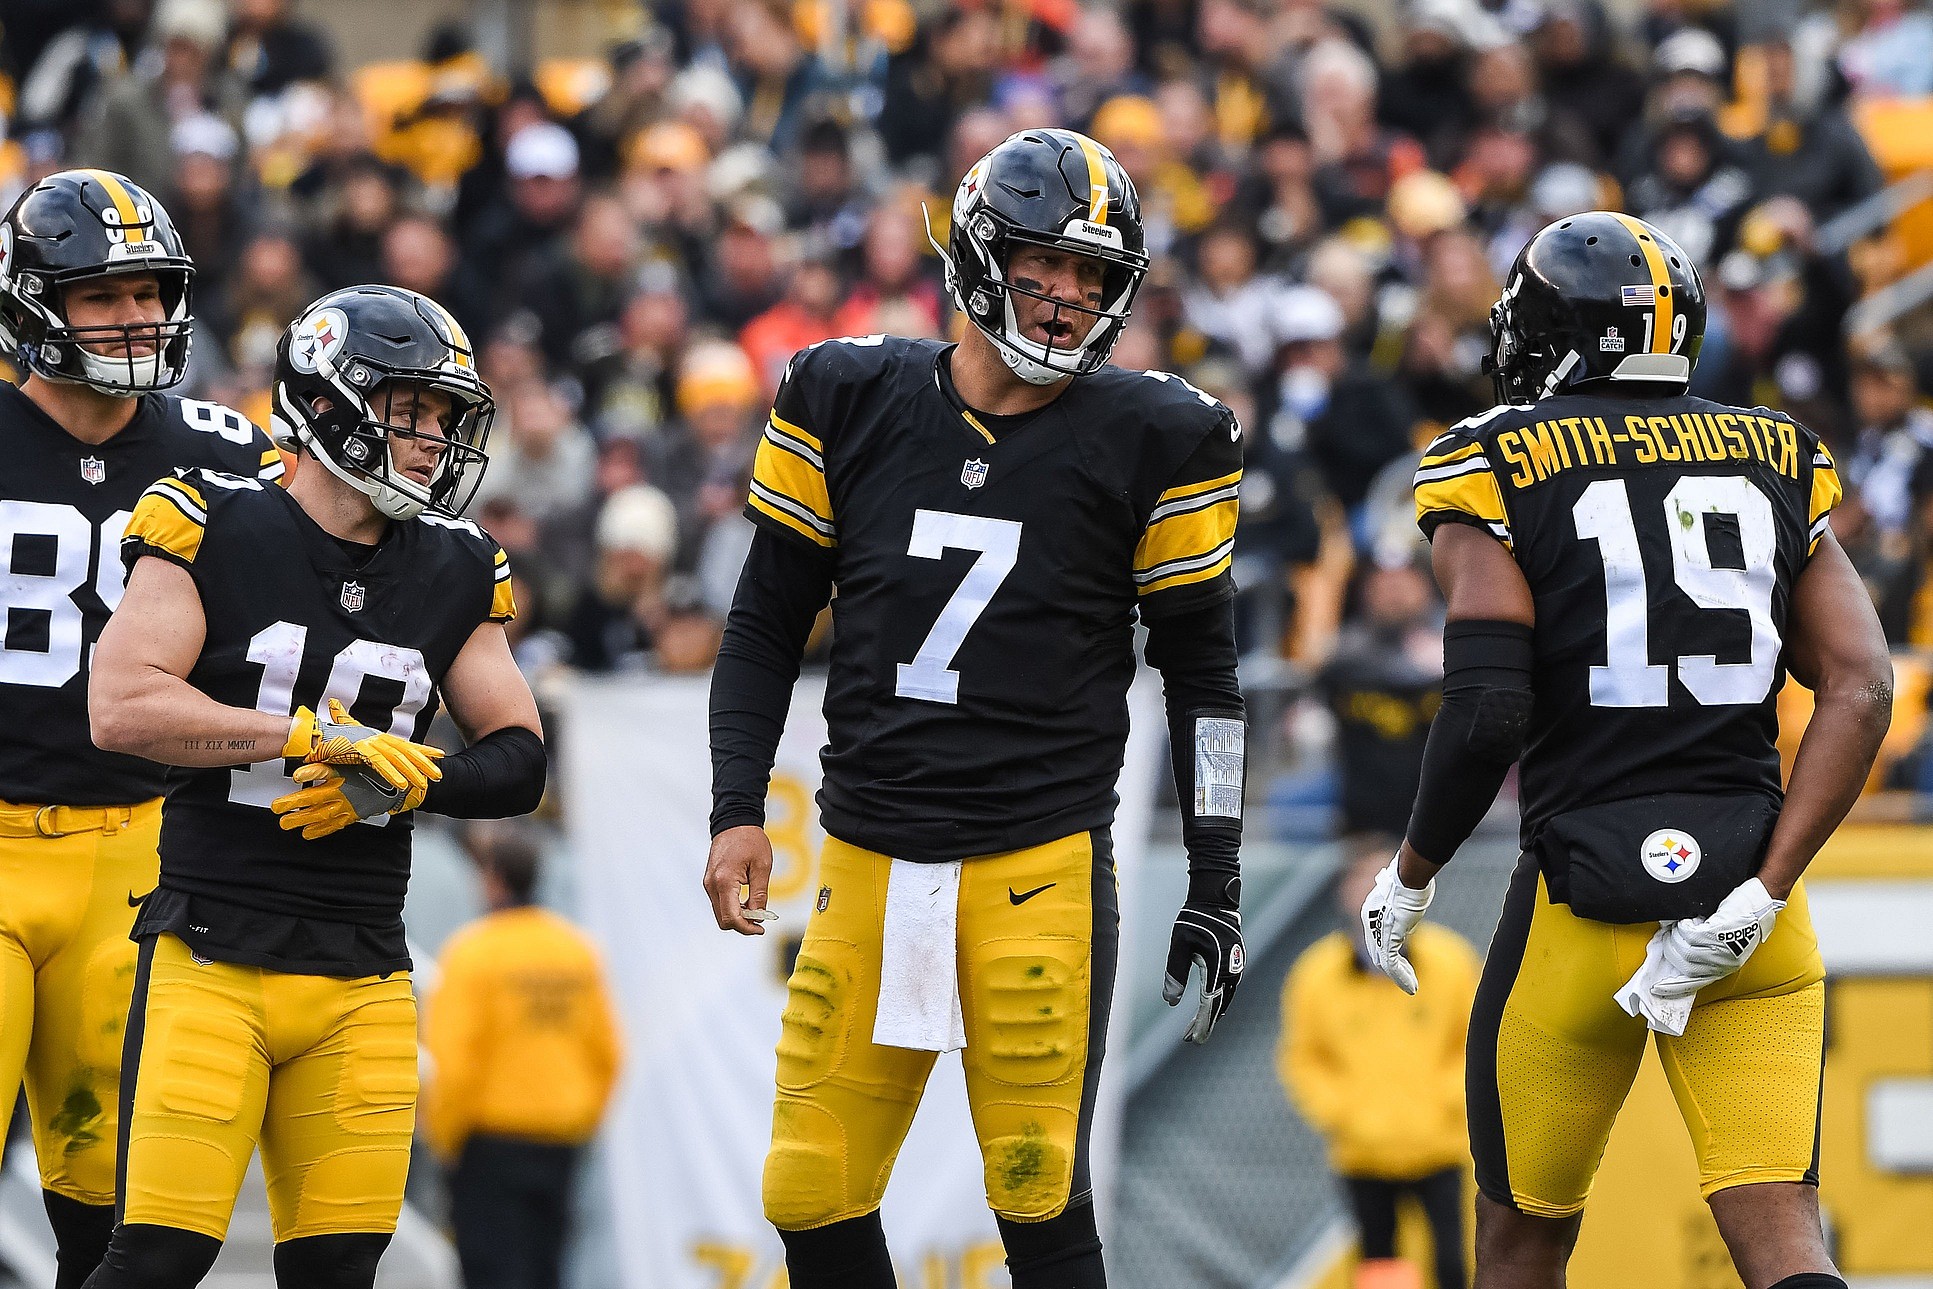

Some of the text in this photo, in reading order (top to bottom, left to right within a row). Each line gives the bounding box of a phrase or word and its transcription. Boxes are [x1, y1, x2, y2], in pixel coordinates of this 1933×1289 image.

[1088, 184, 1109, 222] 7
[1081, 222, 1113, 239] Steelers
[125, 242, 155, 254] Steelers
[1642, 312, 1687, 354] 19
[1497, 413, 1800, 489] SMITH-SCHUSTER
[86, 468, 101, 479] NFL
[964, 470, 983, 484] NFL
[344, 593, 361, 607] NFL
[1572, 475, 1783, 708] 19
[895, 508, 1024, 705] 7
[228, 620, 433, 828] 10
[184, 740, 257, 750] III XIX MMXVI
[1648, 851, 1669, 859] Steelers
[1717, 922, 1760, 942] adidas
